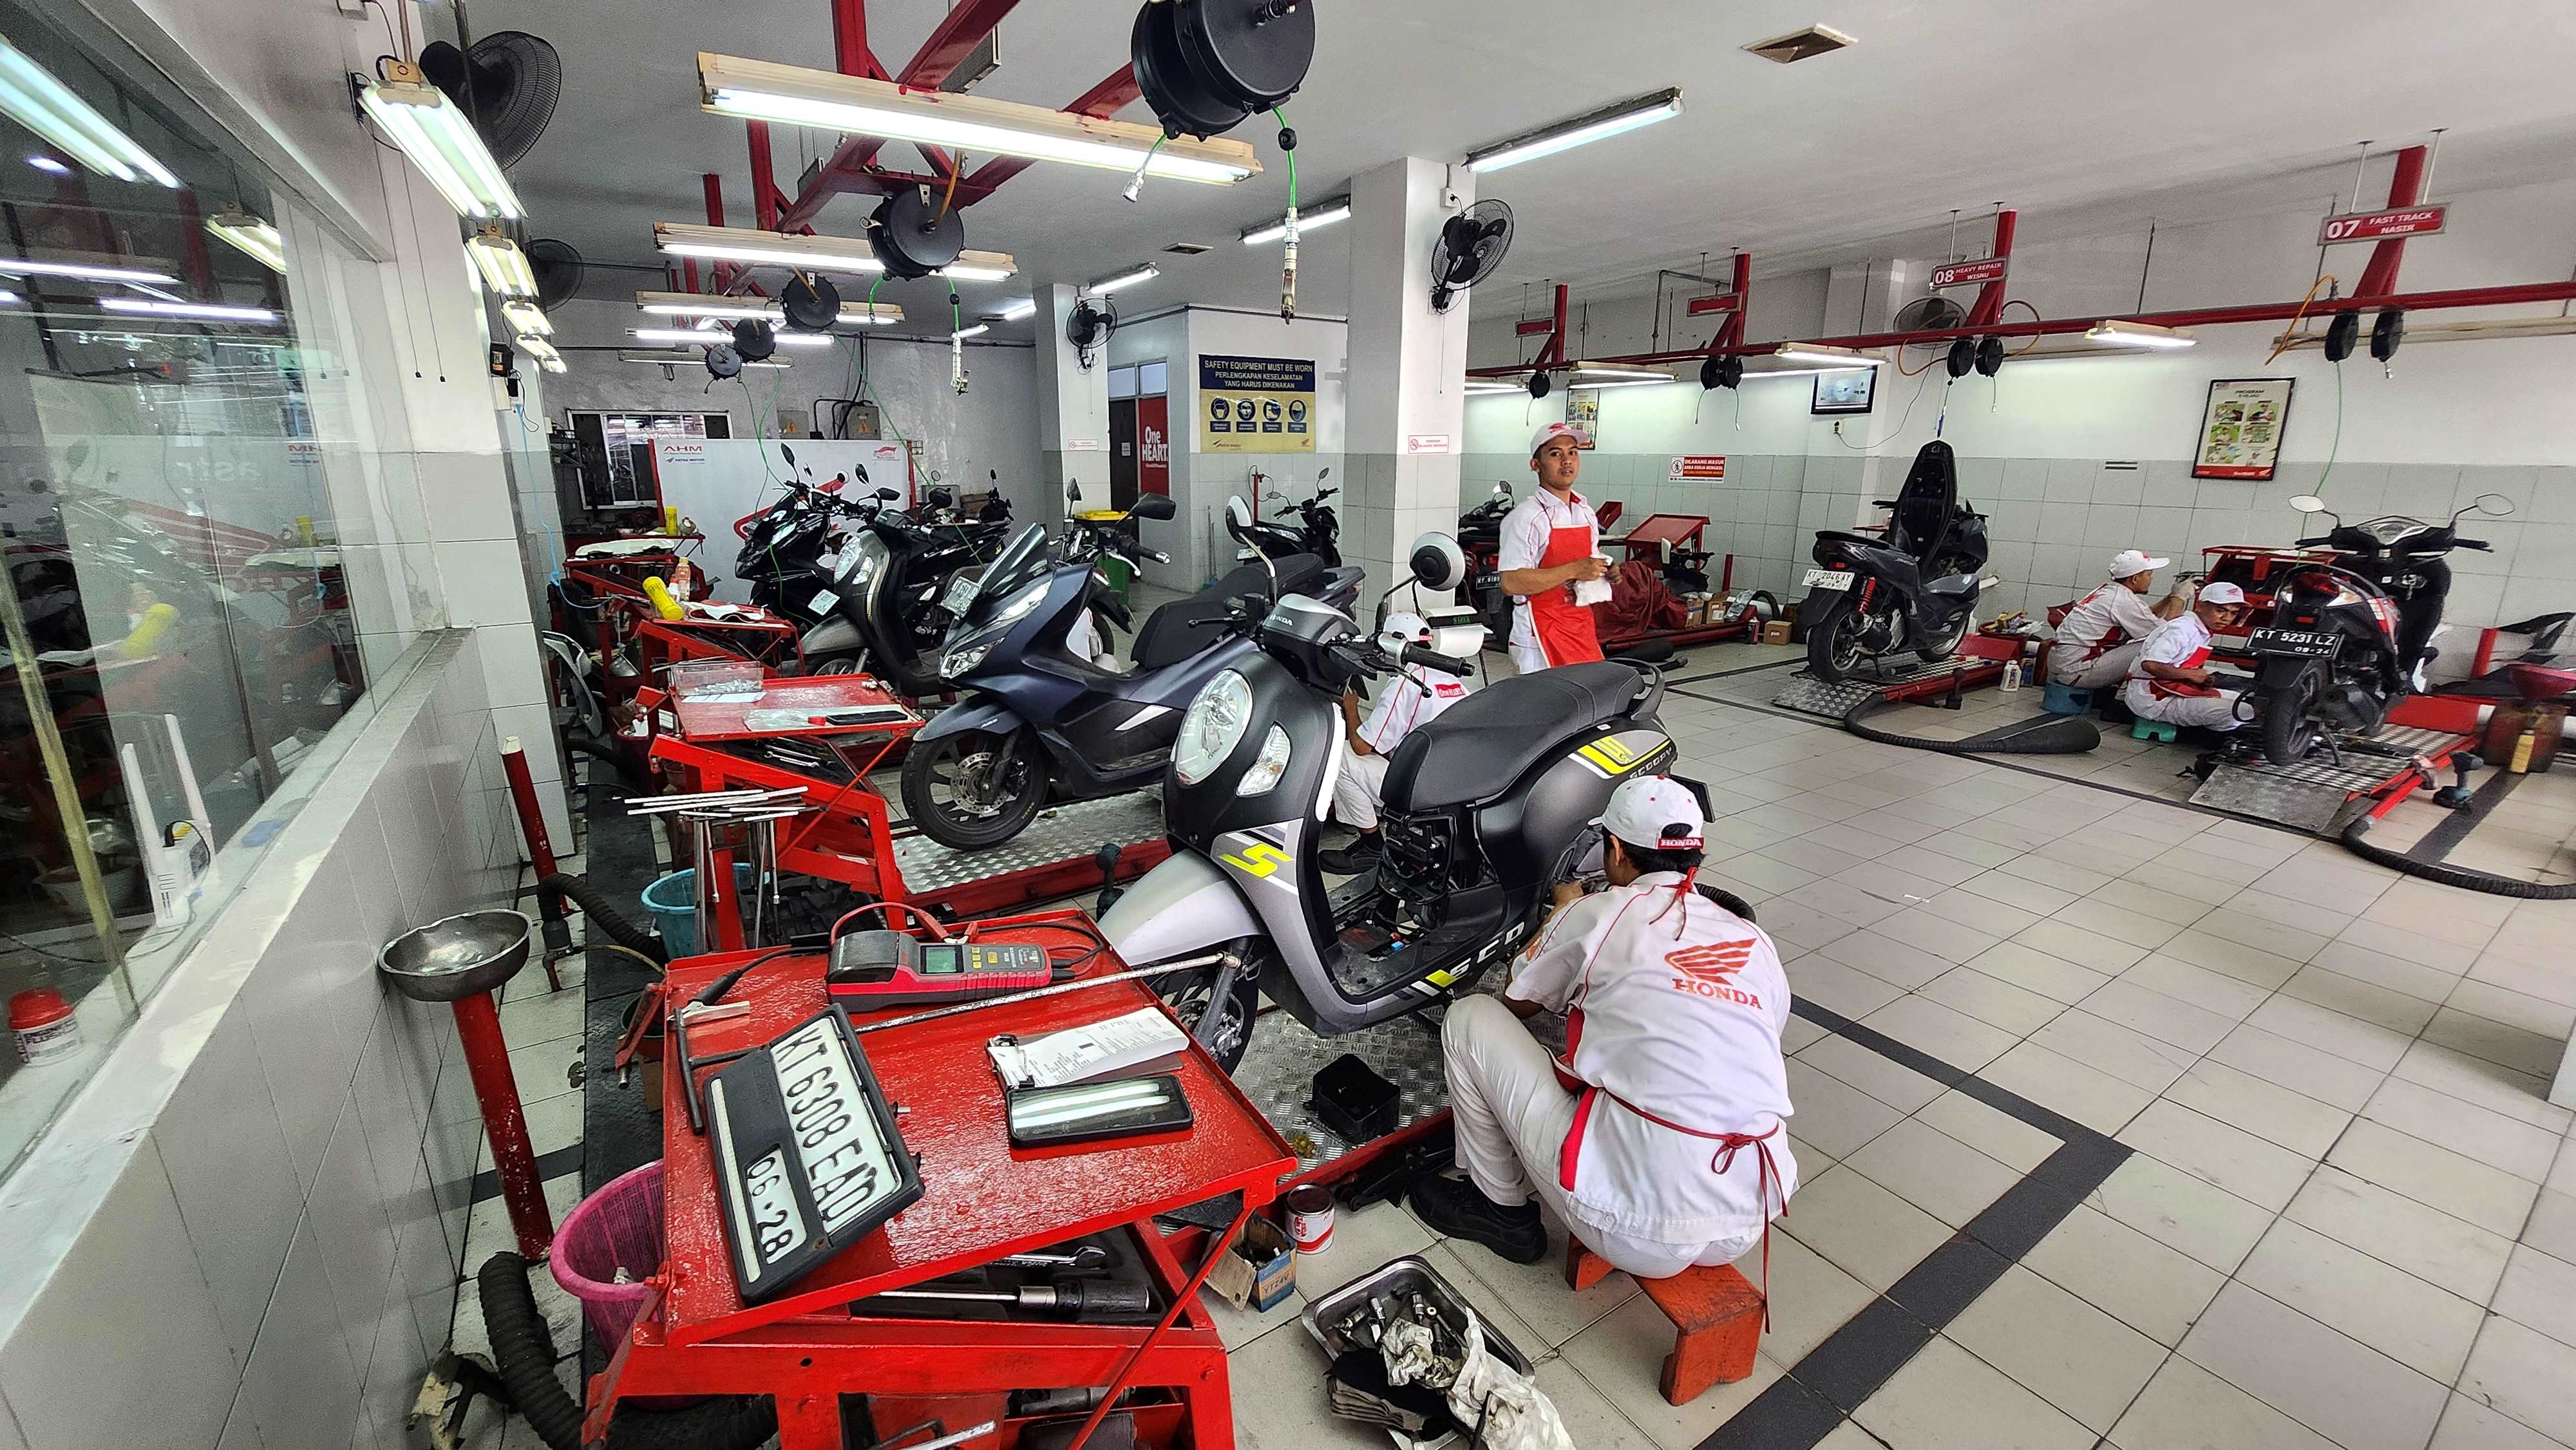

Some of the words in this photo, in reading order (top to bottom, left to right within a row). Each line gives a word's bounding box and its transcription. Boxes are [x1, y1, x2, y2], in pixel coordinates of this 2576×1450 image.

[2369, 216, 2394, 225] FAST
[2398, 211, 2433, 222] TRACK
[2327, 220, 2360, 239] 07
[2380, 224, 2416, 234] NASIR
[1935, 270, 1955, 284] 08
[1205, 360, 1229, 369] SAFETY
[1230, 361, 1266, 370] EQUIPMENT
[1267, 363, 1283, 372] MUST
[1294, 364, 1312, 373] WORN
[1215, 372, 1262, 380] PERLENGKAPAN
[1145, 426, 1161, 444] One
[1269, 614, 1293, 626] HNDA
[2255, 630, 2277, 639] KT
[2280, 632, 2313, 644] 5231
[2315, 636, 2336, 646] LZ
[1629, 747, 1672, 779] SCOOPY
[1660, 838, 1703, 847] HONDA
[1672, 978, 1763, 1010] HONDA
[775, 1026, 829, 1075] KT
[786, 1065, 853, 1149] 6308
